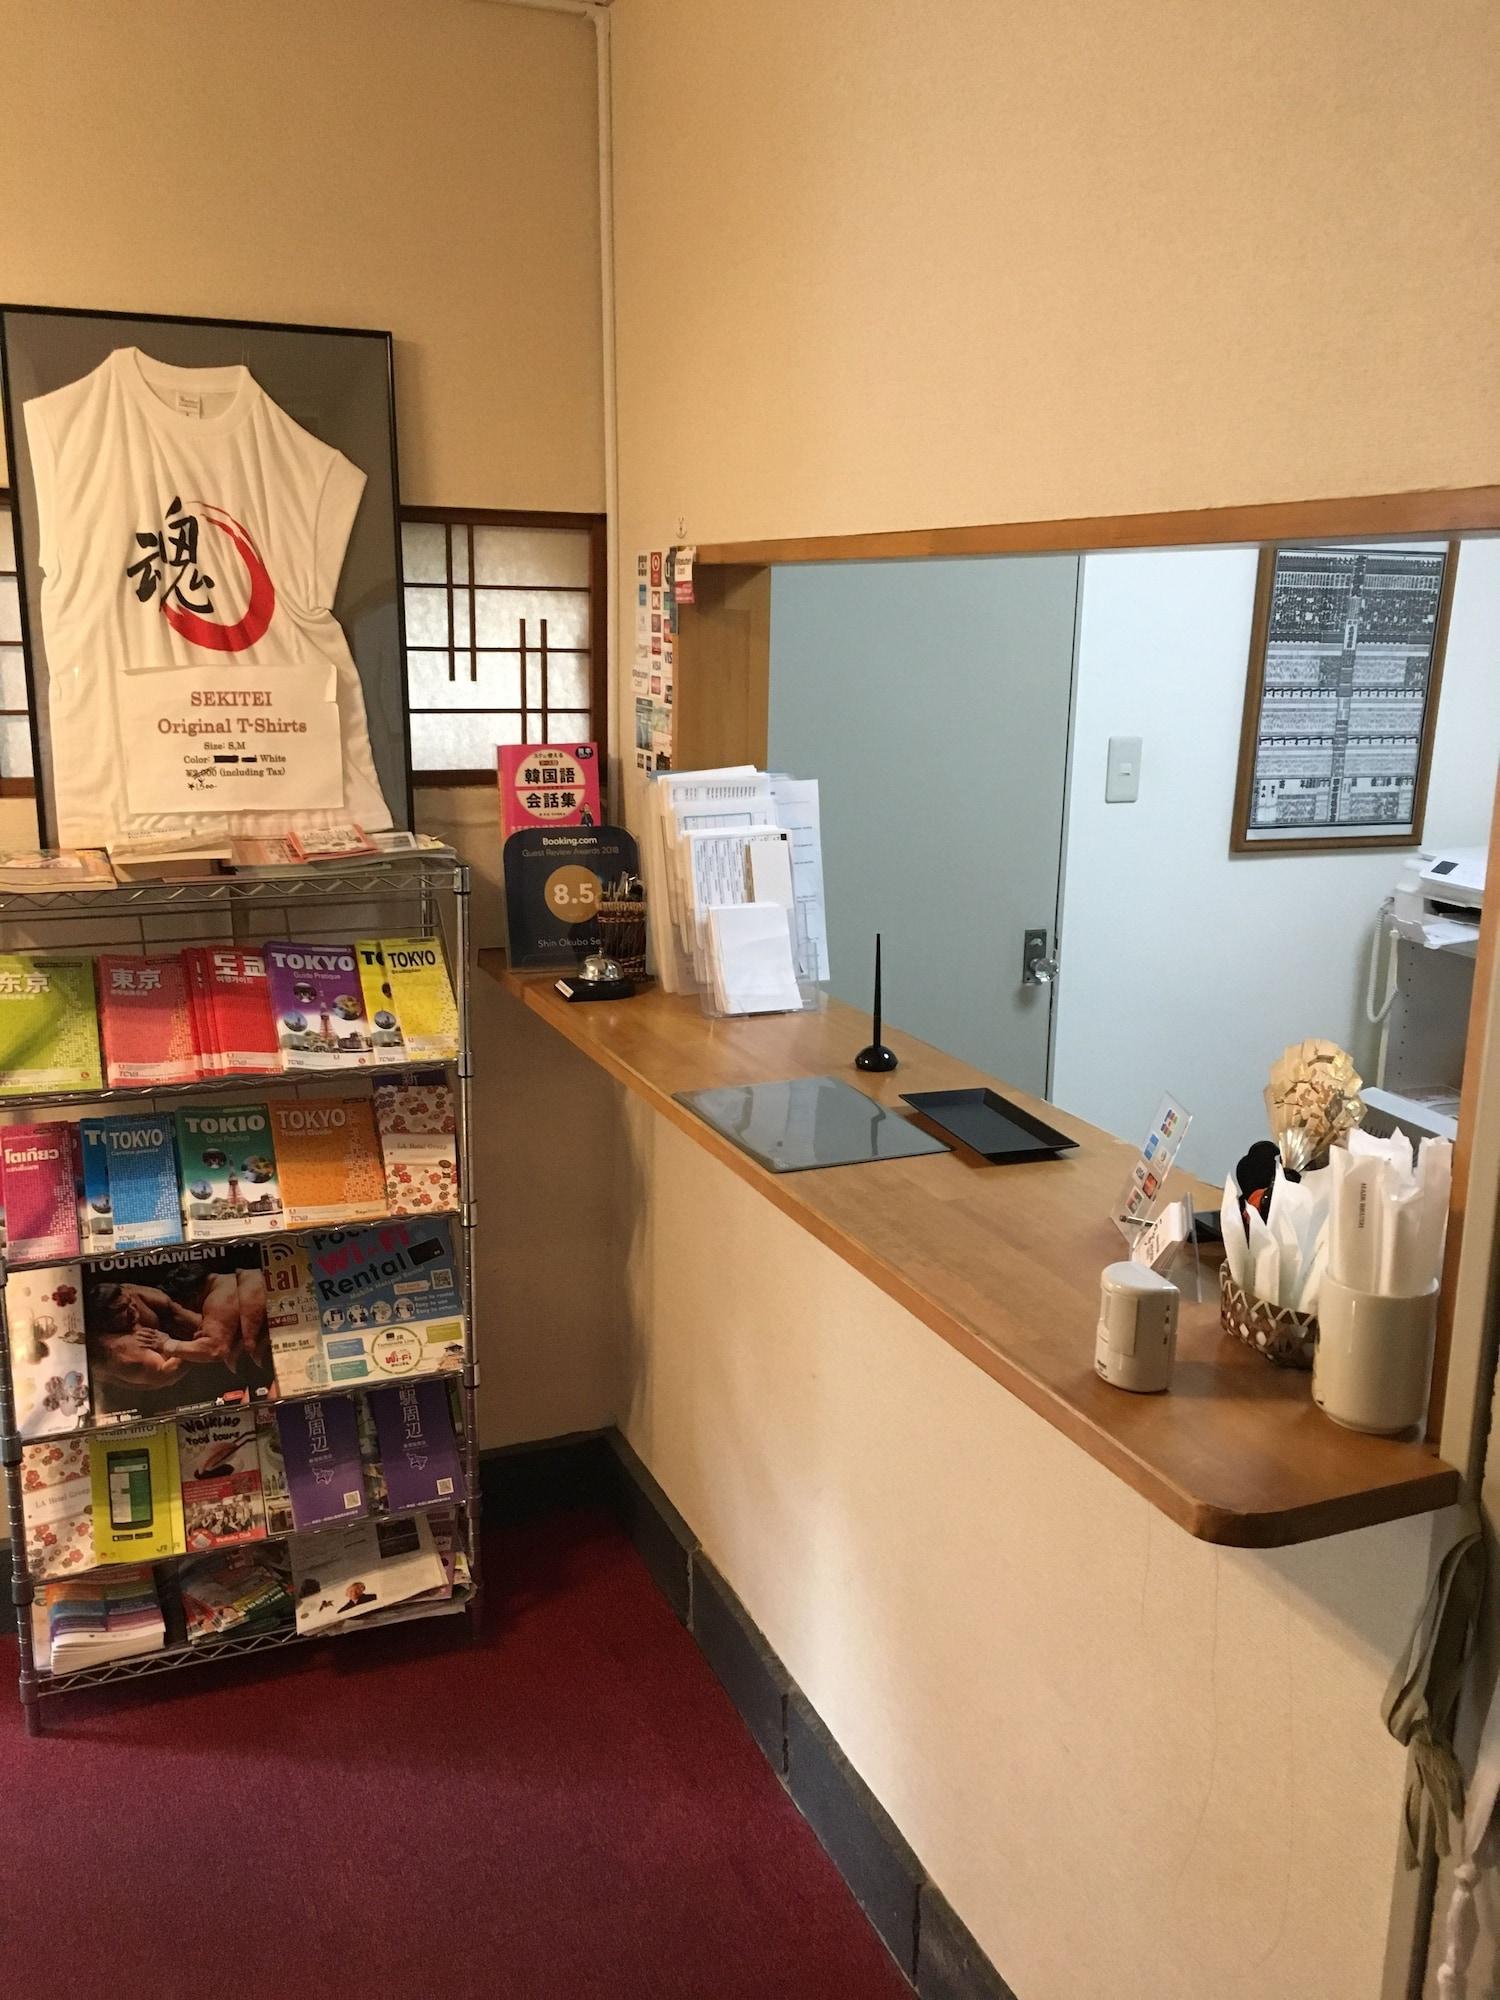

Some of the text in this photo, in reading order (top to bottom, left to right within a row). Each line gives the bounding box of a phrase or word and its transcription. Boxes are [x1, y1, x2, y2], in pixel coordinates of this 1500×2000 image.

[126, 497, 216, 614] 魂
[190, 691, 273, 707] SEKITEI
[157, 717, 308, 737] Original T-Shirts
[203, 741, 226, 750] Size:
[183, 754, 287, 764] Color: White
[219, 768, 264, 778] (including
[267, 767, 286, 777] Tax)
[524, 768, 575, 784] 韓国語
[526, 792, 577, 808] 会話集
[542, 836, 598, 846] Booking.com
[522, 849, 545, 857] Guest
[546, 848, 572, 857] Review
[572, 847, 601, 856] Awards
[553, 882, 594, 905] 8.5
[537, 938, 557, 948] Shin
[559, 937, 589, 947] Okubo
[271, 952, 356, 972] TOKYO
[388, 950, 436, 969] TOKYO
[0, 972, 51, 994] 东京
[110, 968, 162, 990] 東京
[185, 1114, 265, 1134] TOKIO
[278, 1109, 346, 1129] TOKYO
[109, 1128, 163, 1149] TOKYO
[318, 1252, 407, 1301] Rental
